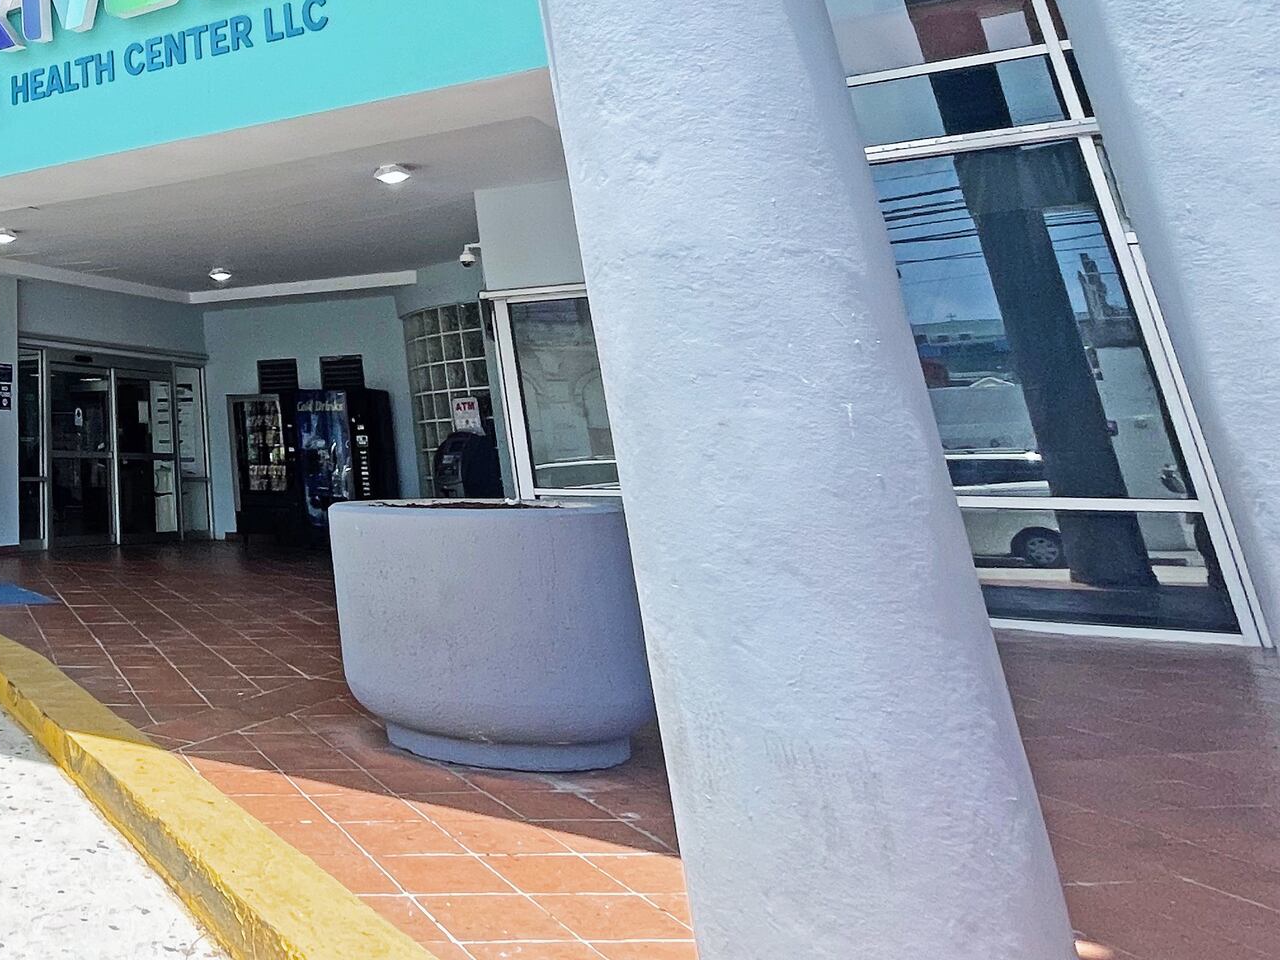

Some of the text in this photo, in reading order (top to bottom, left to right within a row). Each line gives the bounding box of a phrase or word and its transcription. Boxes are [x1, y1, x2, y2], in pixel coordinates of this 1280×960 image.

[10, 50, 115, 106] HEALTH
[123, 14, 254, 76] CENTER
[456, 401, 475, 411] ATM
